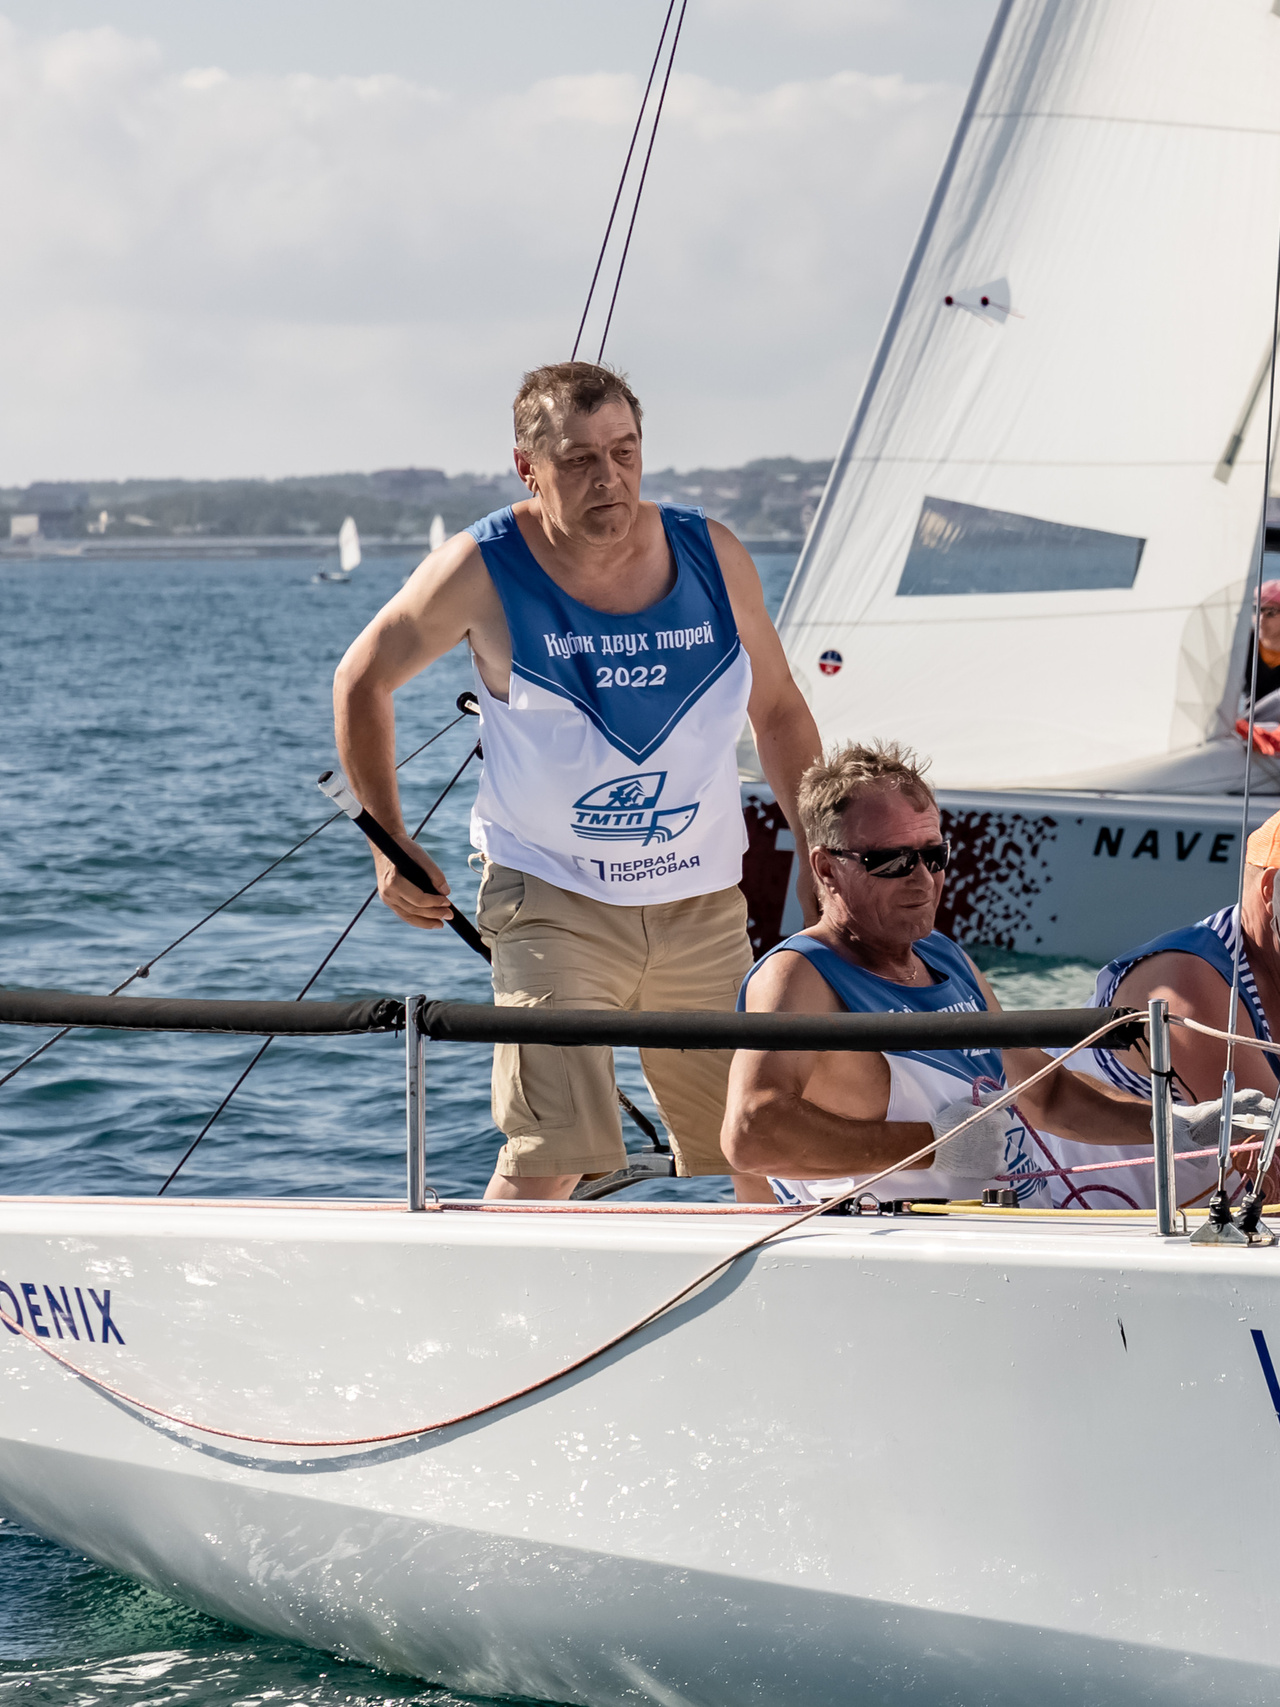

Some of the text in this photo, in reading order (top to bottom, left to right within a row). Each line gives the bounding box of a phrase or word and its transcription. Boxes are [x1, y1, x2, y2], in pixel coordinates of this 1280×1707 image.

[543, 631, 596, 660] Кубок
[600, 632, 650, 657] двух
[596, 664, 668, 688] 2022
[575, 811, 645, 826] ТМТП
[610, 852, 676, 872] ПЕРВАЯ
[610, 855, 700, 882] ПОРТОВАЯ
